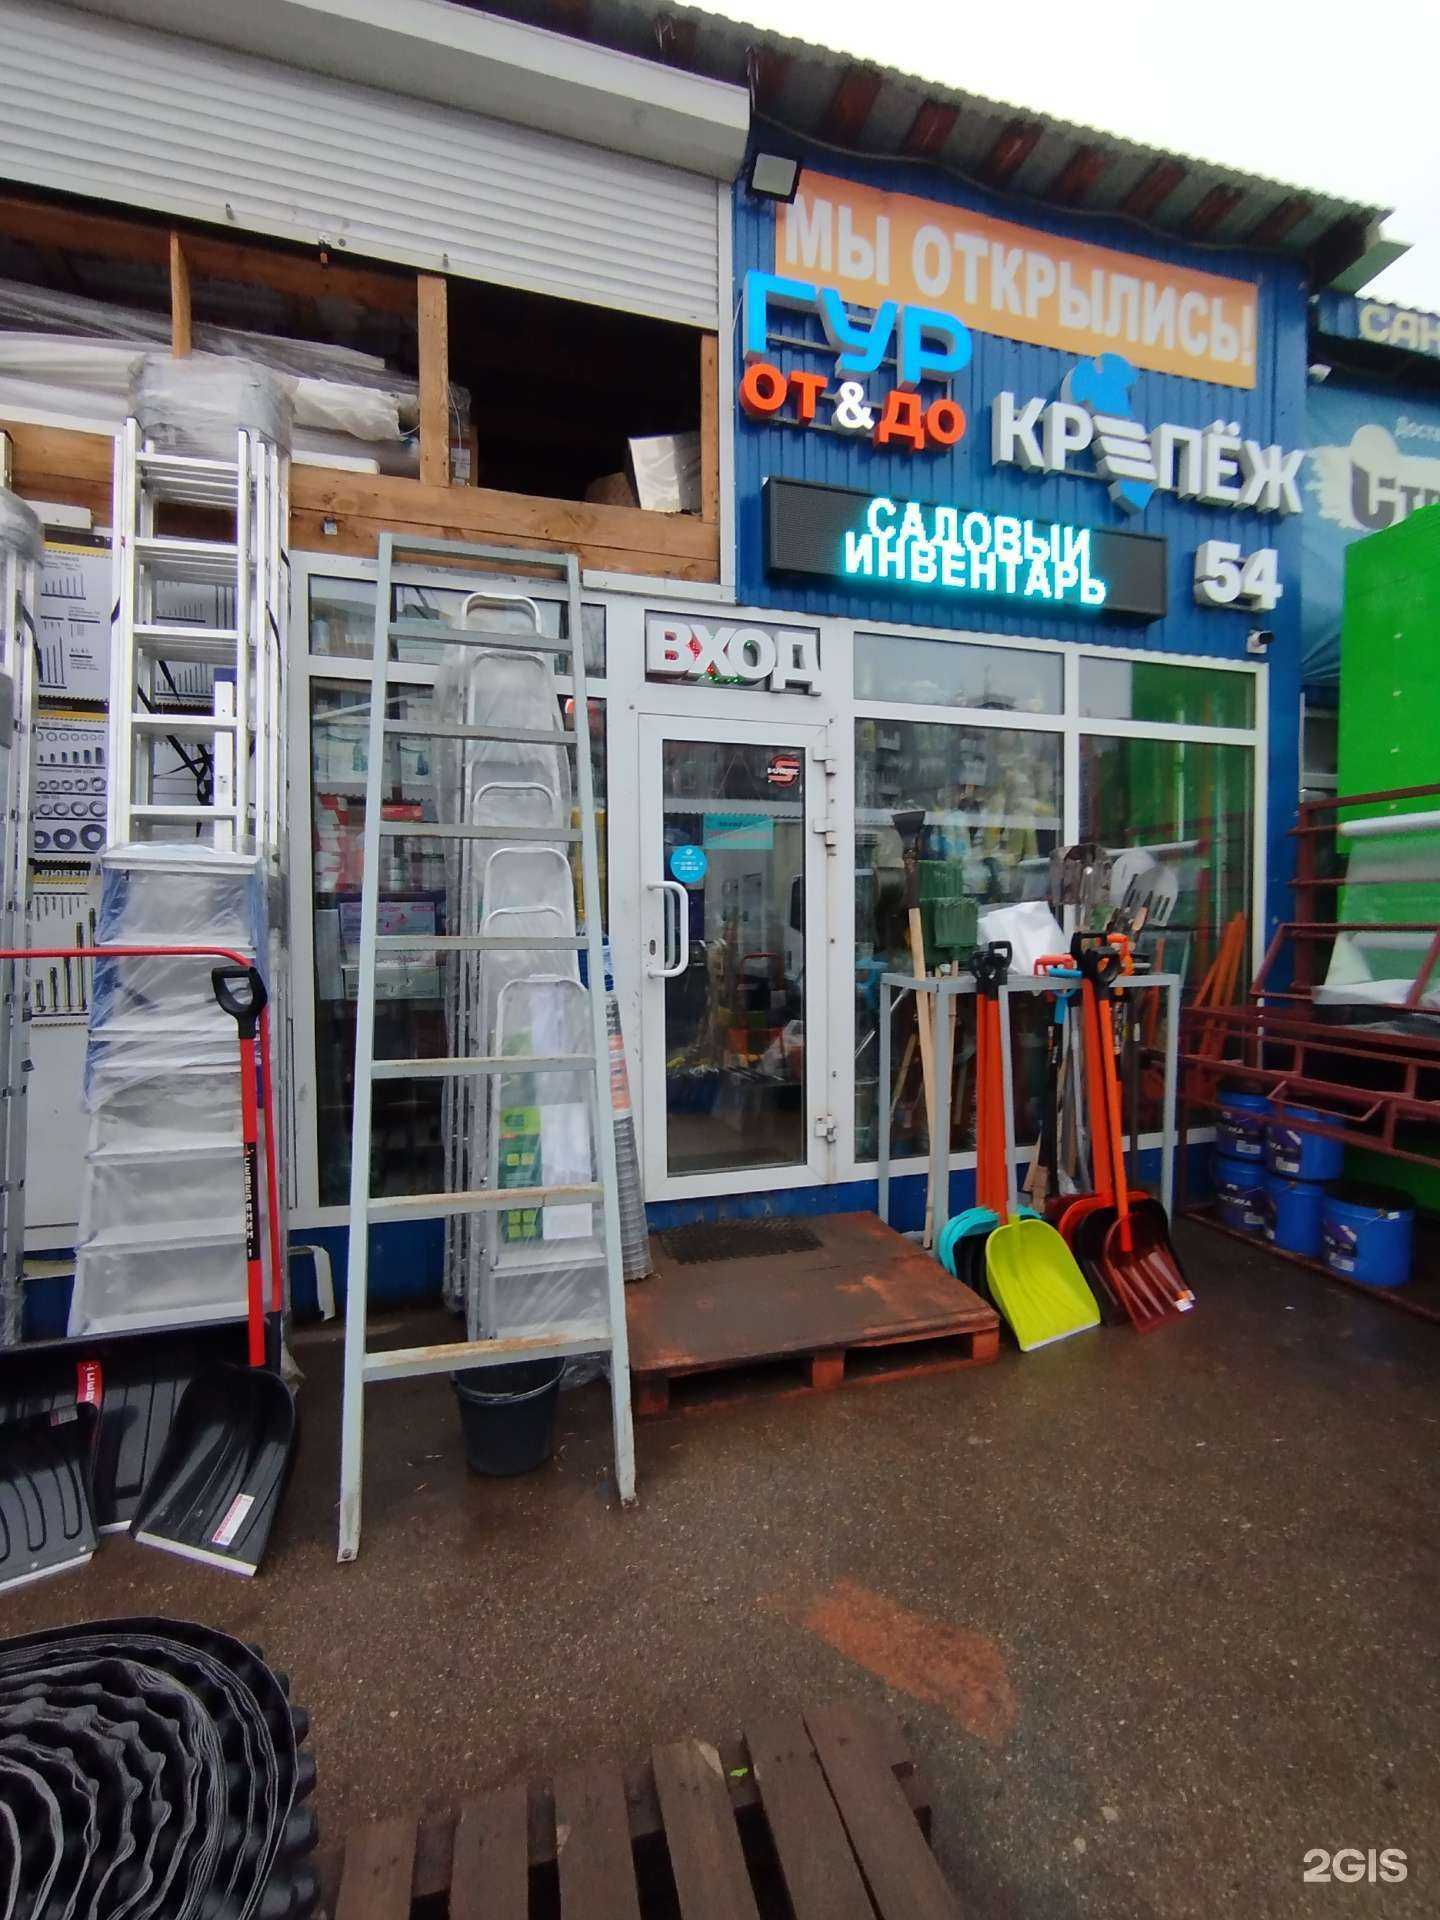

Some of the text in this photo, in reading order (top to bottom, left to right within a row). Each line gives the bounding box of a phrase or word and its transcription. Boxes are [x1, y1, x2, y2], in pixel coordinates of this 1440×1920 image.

[785, 191, 1254, 367] МЫ ОТКРЫЛИСЬ!
[742, 270, 972, 388] ГУР
[845, 531, 1107, 606] ИНВЕНТАРЬ
[1195, 539, 1284, 612] 54
[648, 619, 822, 696] ВХОД
